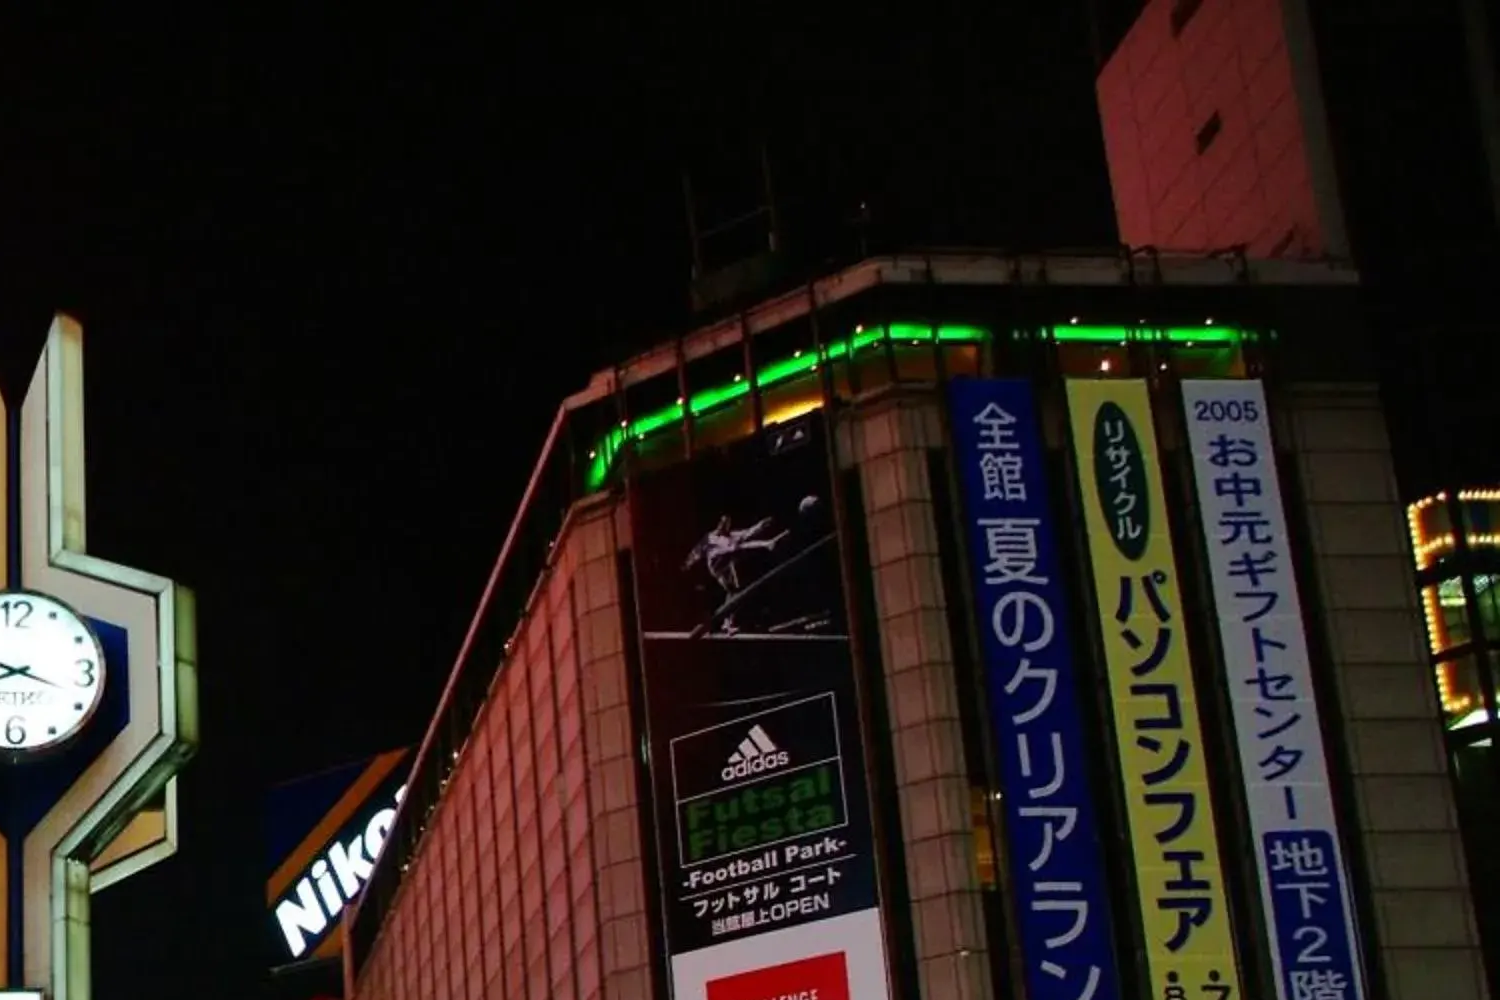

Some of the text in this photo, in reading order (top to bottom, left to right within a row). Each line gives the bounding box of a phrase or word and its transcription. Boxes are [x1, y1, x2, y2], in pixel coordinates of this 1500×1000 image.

[1195, 401, 1259, 422] 2005
[1102, 419, 1143, 541] リサイクル
[0, 600, 34, 629] 12
[1208, 433, 1302, 820] お中元ギフトセンター
[74, 658, 95, 687] 3
[4, 714, 27, 745] 6
[721, 750, 790, 781] adidas
[1114, 568, 1214, 952] パソコンフェア
[686, 766, 831, 829] Futsal
[689, 804, 835, 859] Fiesta
[693, 867, 842, 917] フットサル コート
